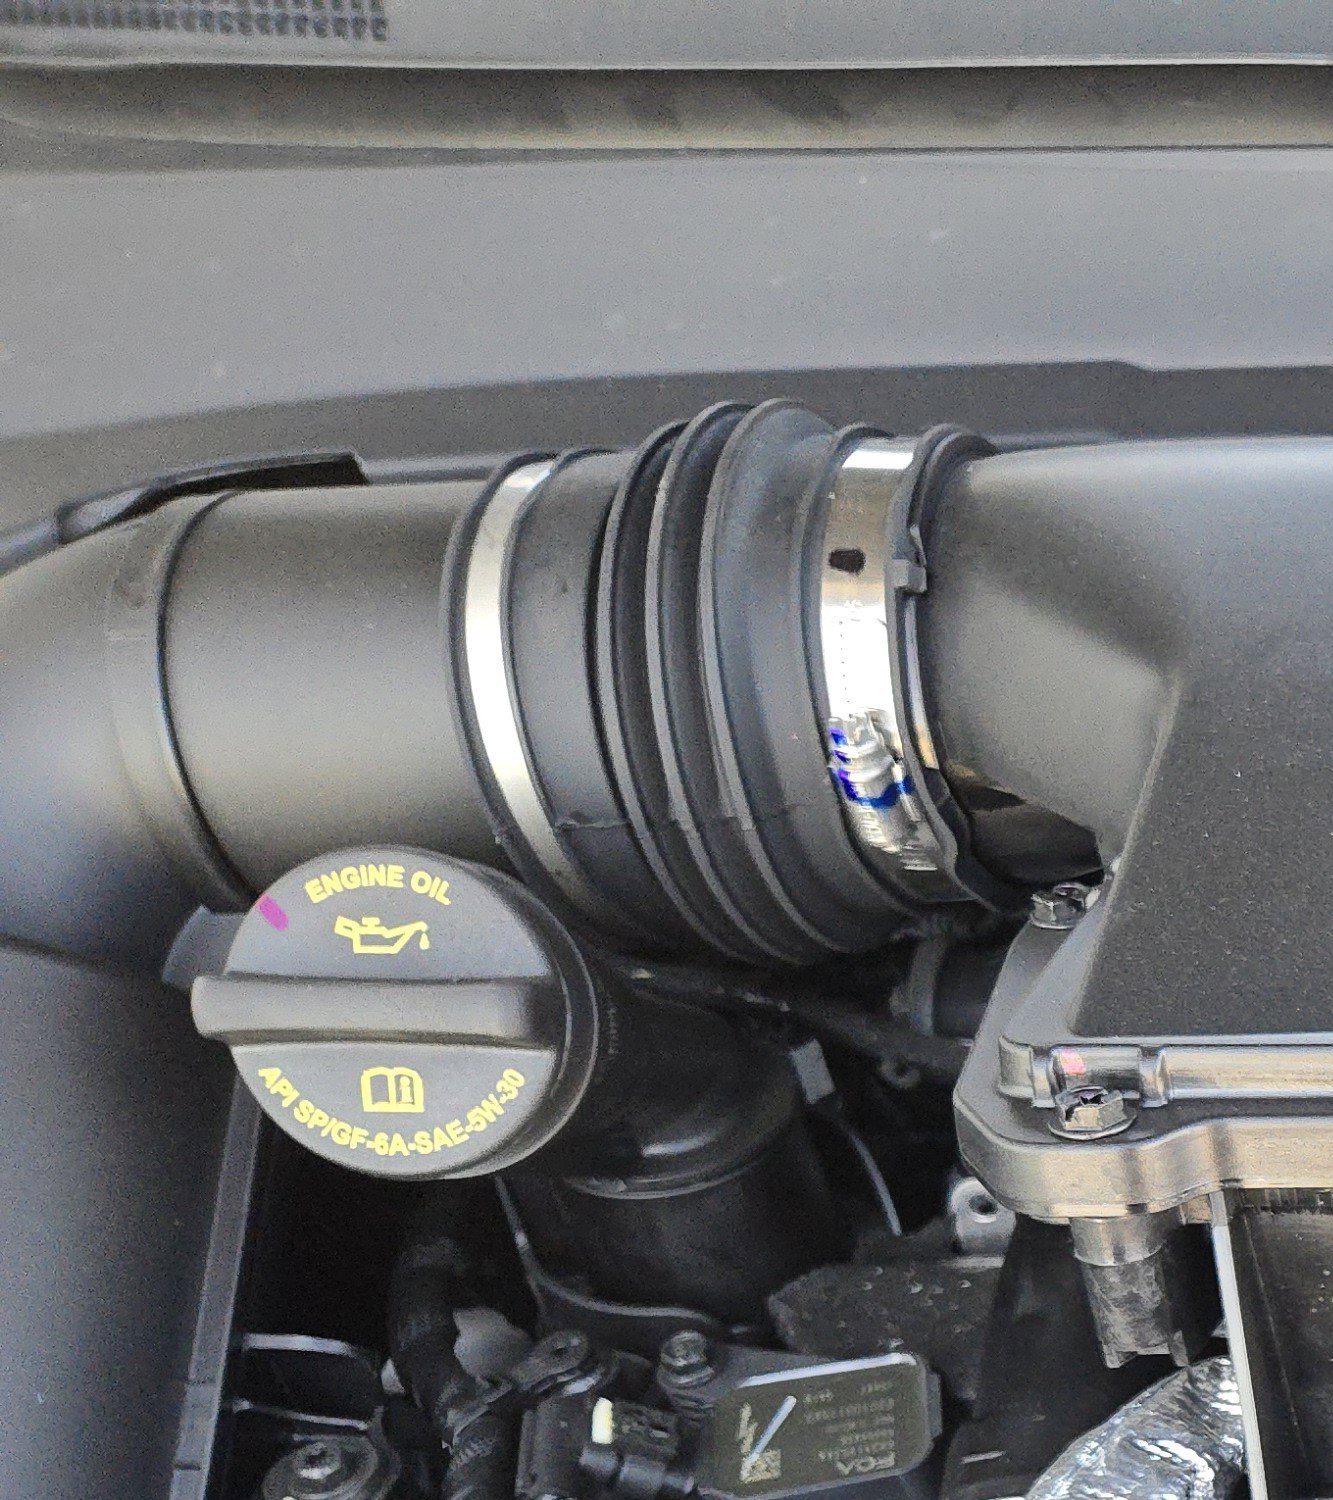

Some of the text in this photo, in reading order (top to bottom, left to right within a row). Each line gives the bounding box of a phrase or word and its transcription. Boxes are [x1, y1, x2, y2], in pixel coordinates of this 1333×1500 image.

[304, 864, 453, 906] ENGINE OIL
[257, 1066, 295, 1109] API
